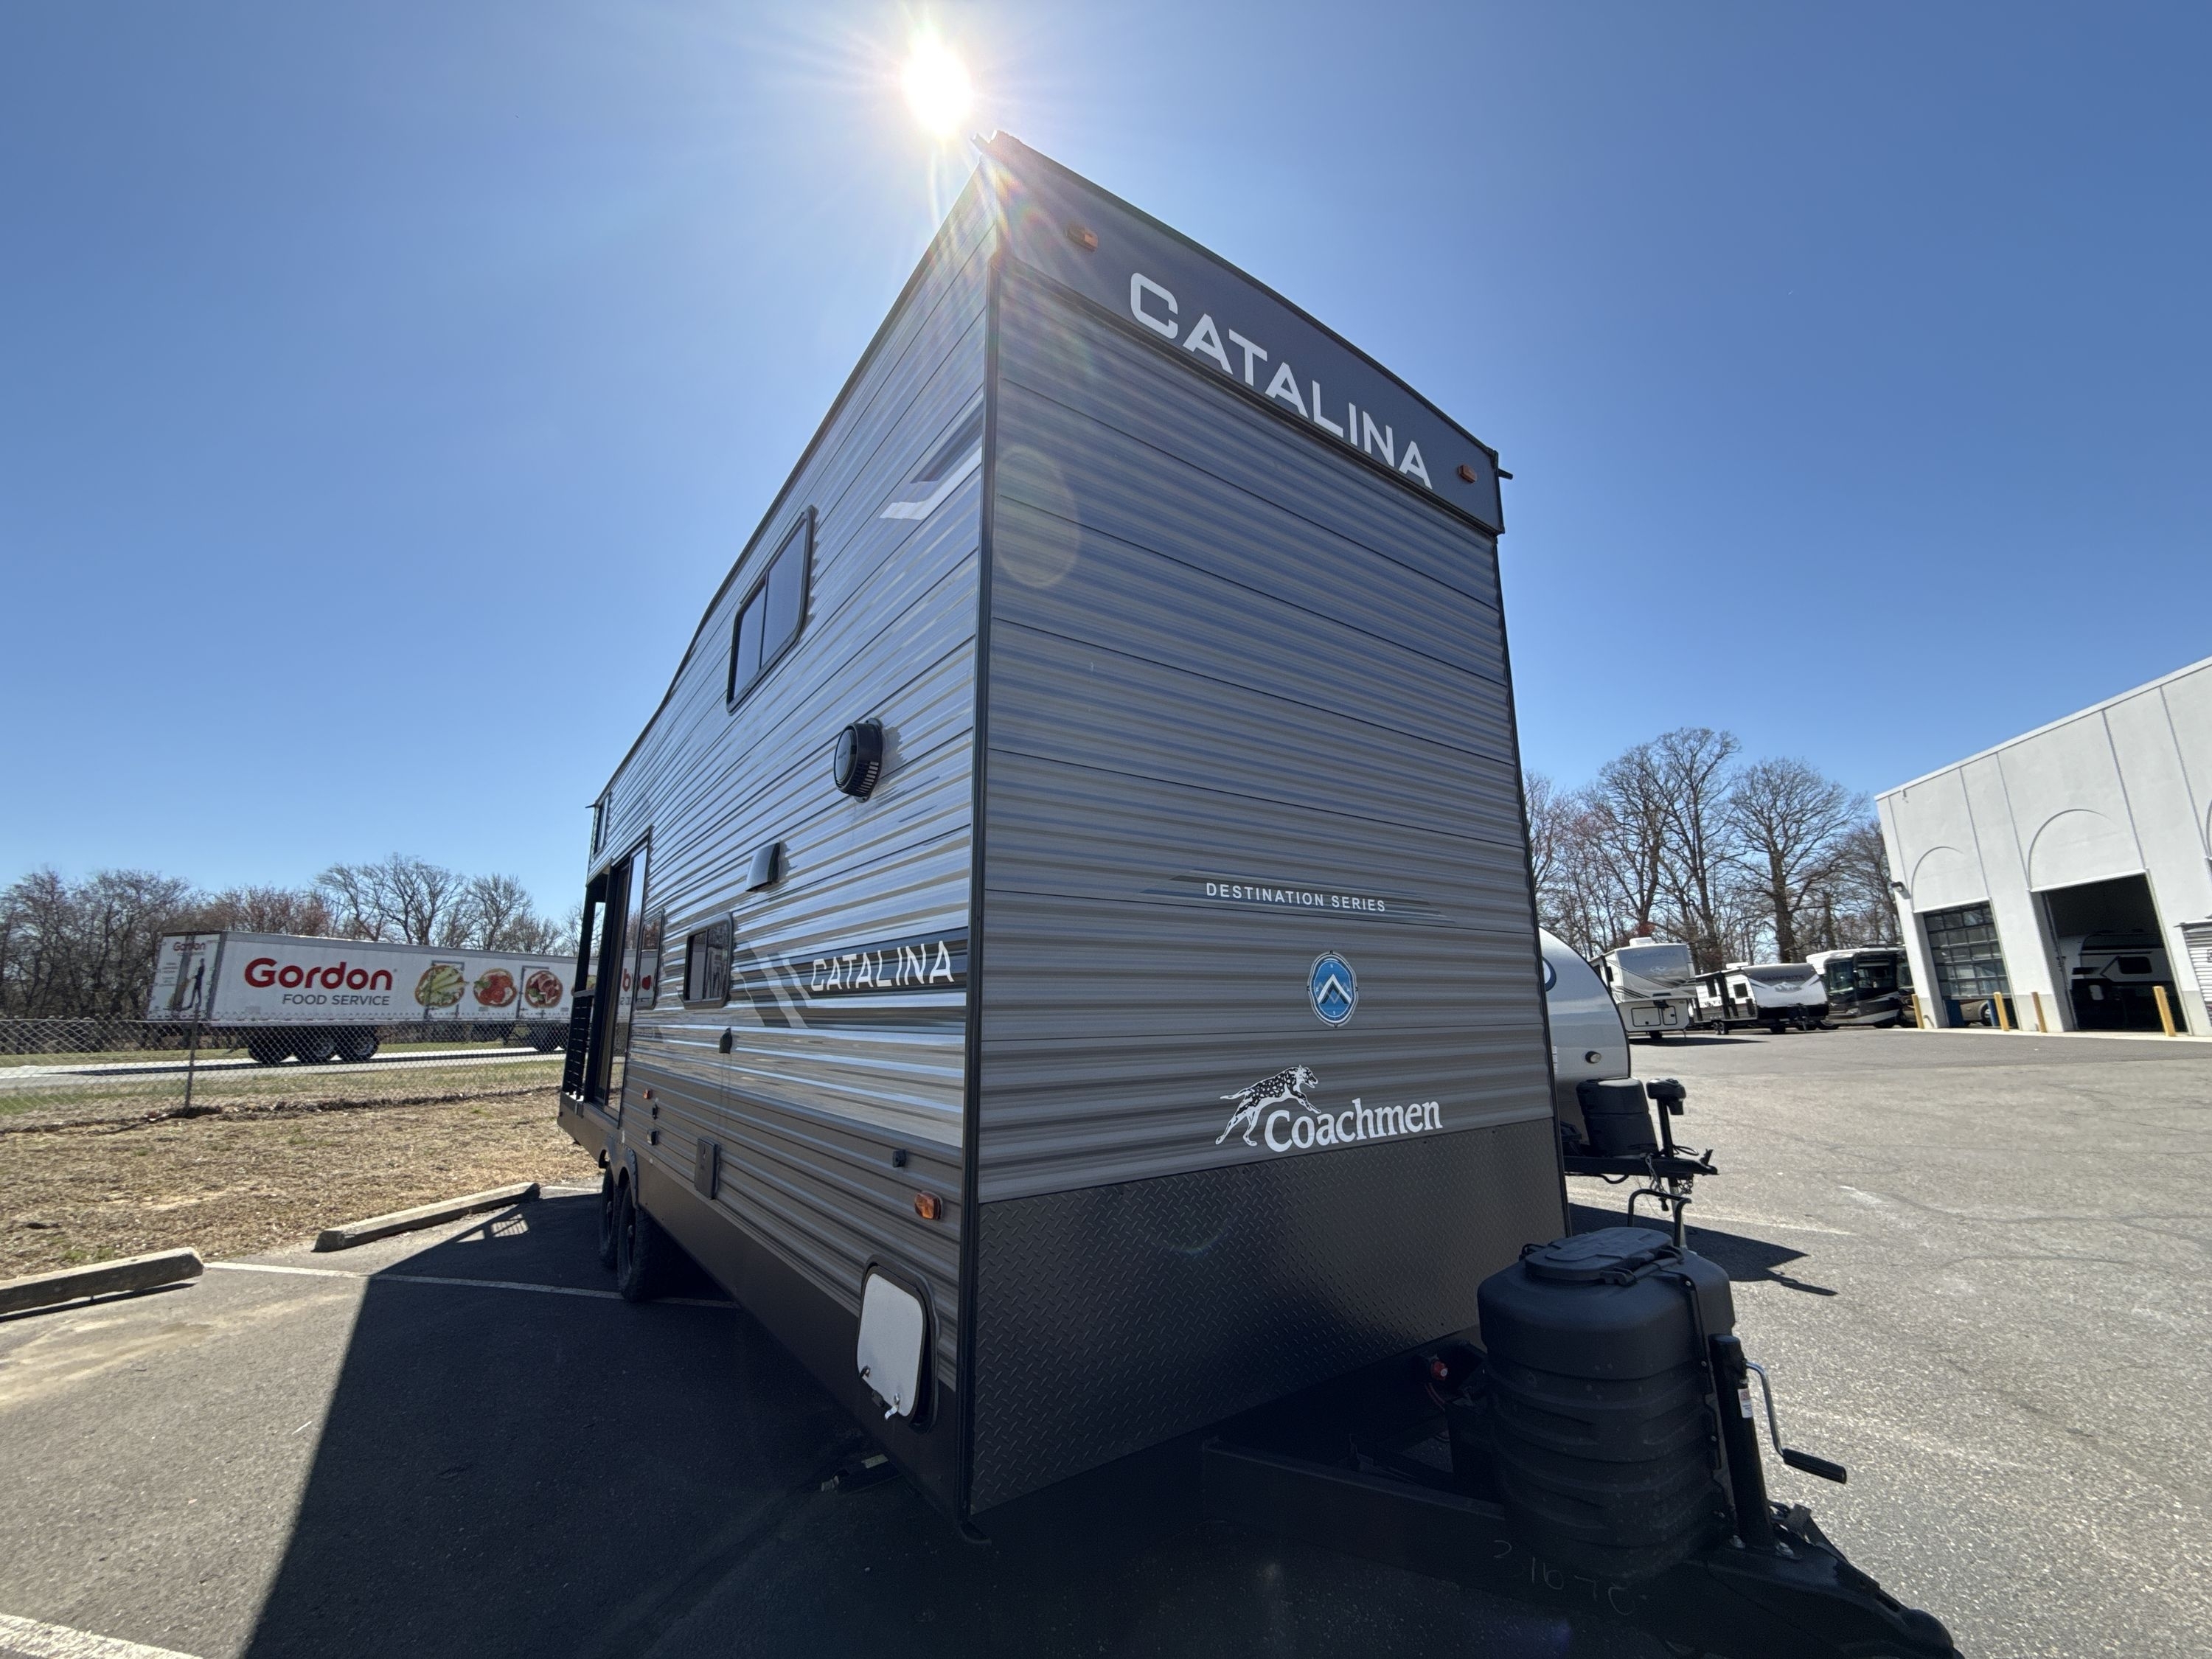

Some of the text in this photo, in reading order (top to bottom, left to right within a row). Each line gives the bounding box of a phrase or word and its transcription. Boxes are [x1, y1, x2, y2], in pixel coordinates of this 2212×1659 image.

[1130, 272, 1433, 490] CATALINA
[1206, 882, 1385, 912] DESTINATION SERIES
[244, 957, 393, 991] Gordon
[811, 940, 954, 992] CATALINA
[282, 993, 391, 1006] FOOD SERVICE
[1264, 1097, 1444, 1152] Coachmen
